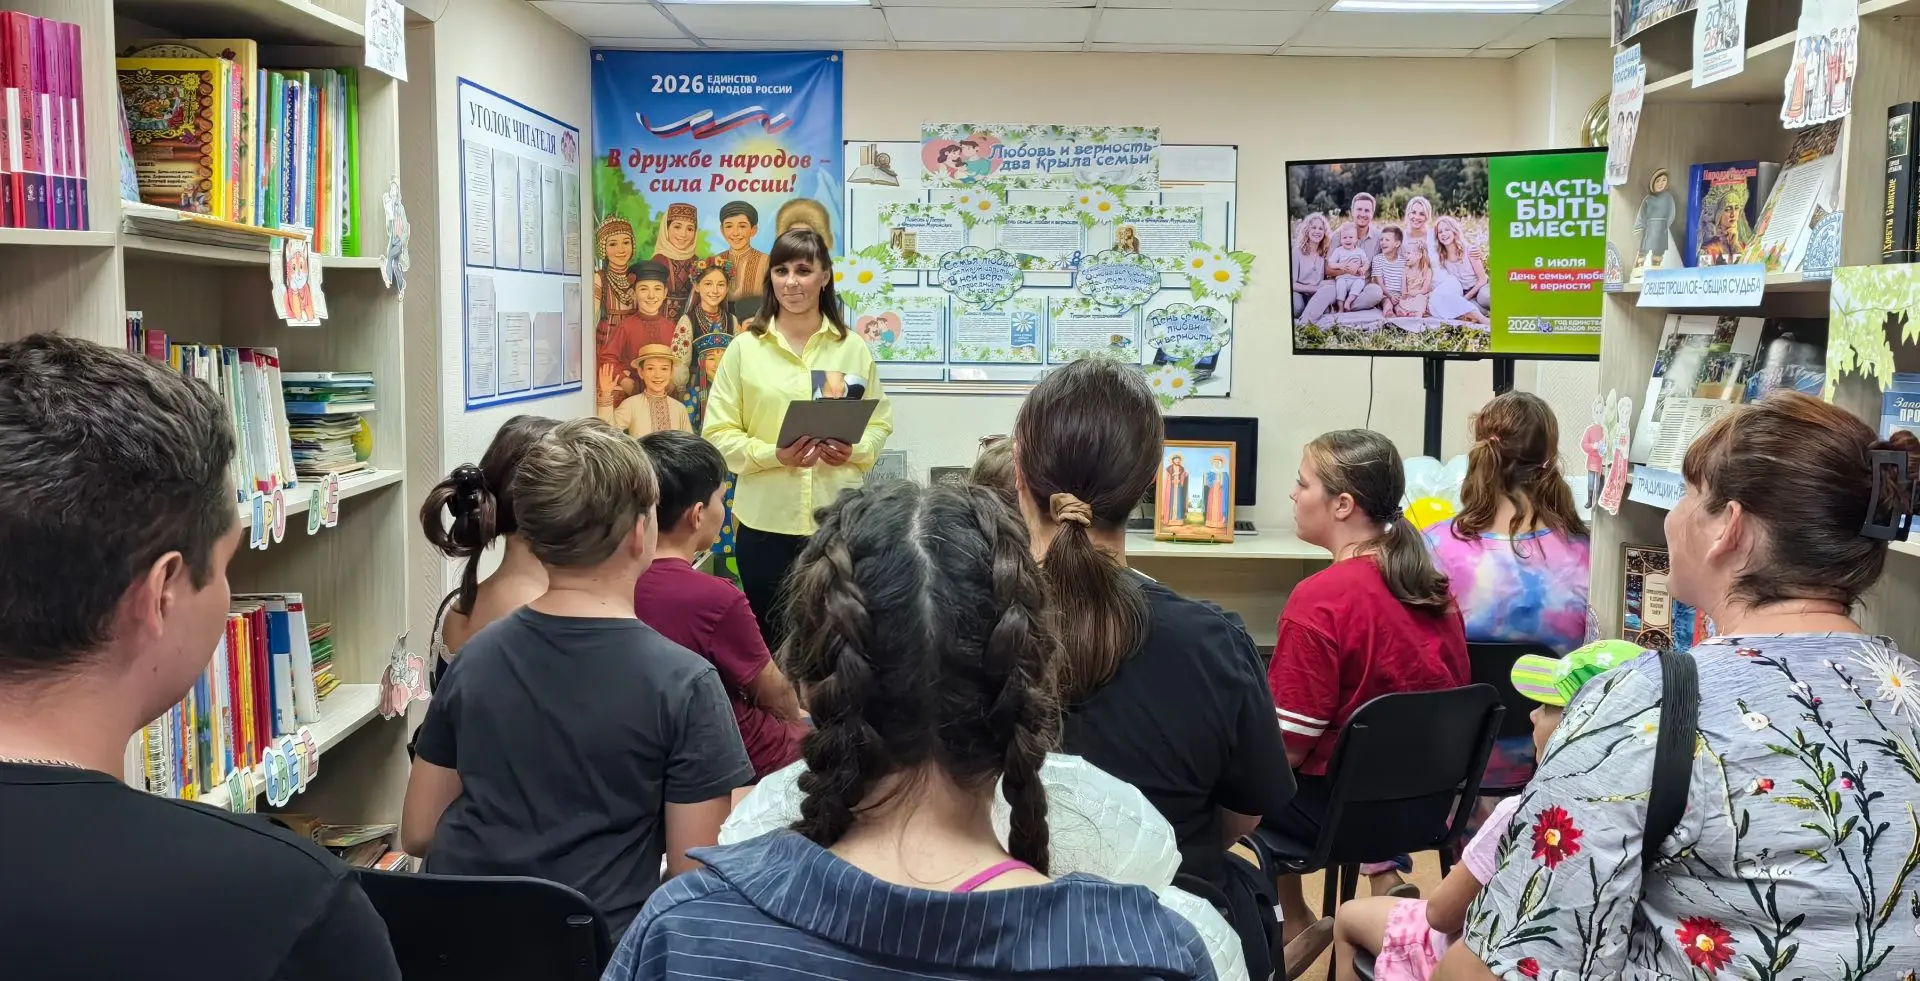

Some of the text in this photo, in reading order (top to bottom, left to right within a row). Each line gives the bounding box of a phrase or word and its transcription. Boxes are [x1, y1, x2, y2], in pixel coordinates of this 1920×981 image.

[651, 75, 704, 93] 2026
[707, 75, 757, 84] ЕДИНСТВО
[707, 85, 792, 95] НАРОДОВ РОССИИ
[470, 101, 557, 155] УГОЛОК ЧИТАТЕЛЯ
[988, 142, 1056, 160] Любовь
[1060, 145, 1070, 156] и
[607, 149, 622, 168] В
[628, 148, 713, 174] дружбе
[719, 148, 812, 174] народов
[1000, 158, 1031, 172] два
[1095, 153, 1150, 166] семьи
[649, 173, 797, 193] сила России!
[1516, 197, 1606, 220] БЫТЬ
[1510, 220, 1606, 238] ВМЕСТЕ
[943, 257, 979, 271] Семья
[1534, 257, 1586, 267] 8 июля
[948, 275, 958, 286] В
[1509, 271, 1537, 281] День
[1538, 272, 1574, 281] семьи,
[1540, 283, 1591, 291] верности
[1644, 281, 1665, 296] ОБЩЕЕ
[1666, 279, 1698, 295] ПРОШЛОЕ
[1703, 279, 1728, 296] ОБЩАЯ
[1729, 276, 1760, 296] СУДЬБА
[1151, 314, 1212, 328] День семьи
[1167, 320, 1201, 333] любви
[1508, 319, 1536, 331] 2026
[1165, 333, 1213, 344] верности
[252, 489, 285, 545] ПРО
[264, 729, 318, 802] СВЕТЕ
